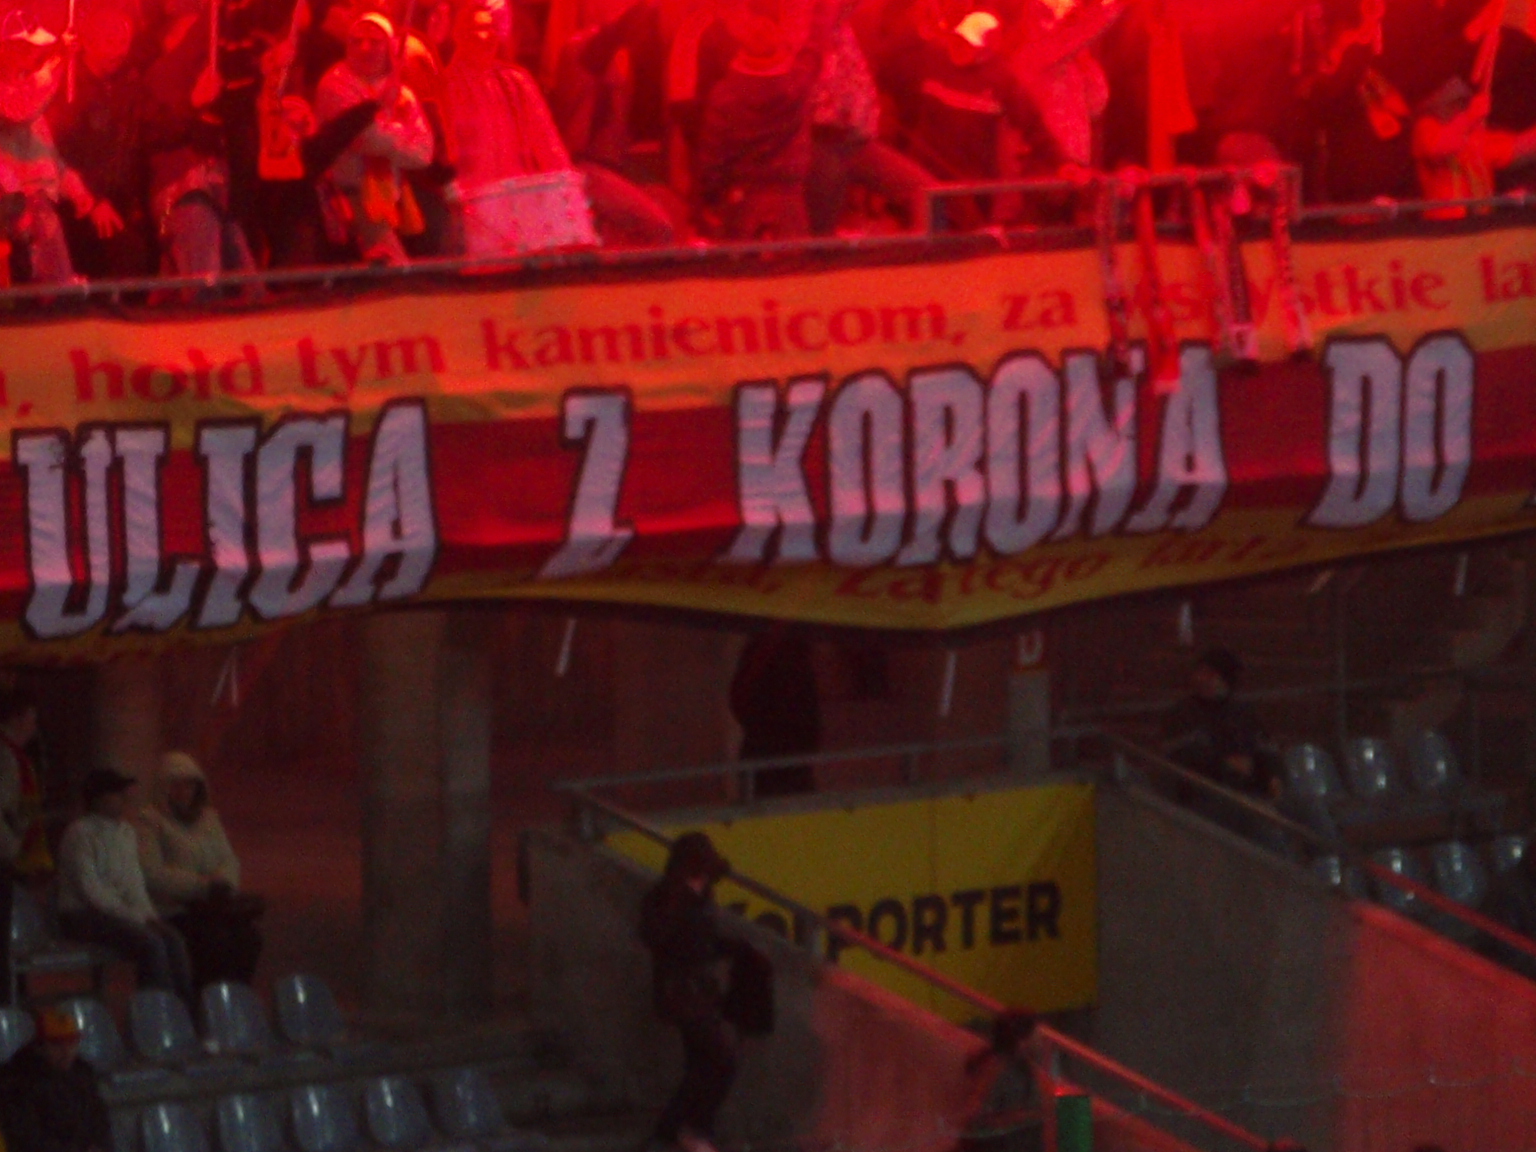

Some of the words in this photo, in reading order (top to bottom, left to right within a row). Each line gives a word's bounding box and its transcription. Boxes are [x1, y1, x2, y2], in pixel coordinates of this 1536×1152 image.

[297, 332, 446, 400] tym
[480, 299, 968, 373] kamienicom,
[1002, 289, 1077, 332] za
[1478, 252, 1536, 302] la
[12, 395, 440, 640] ULICA
[538, 385, 636, 583] Z
[720, 337, 1230, 568] KORONA
[1298, 329, 1476, 530] DO
